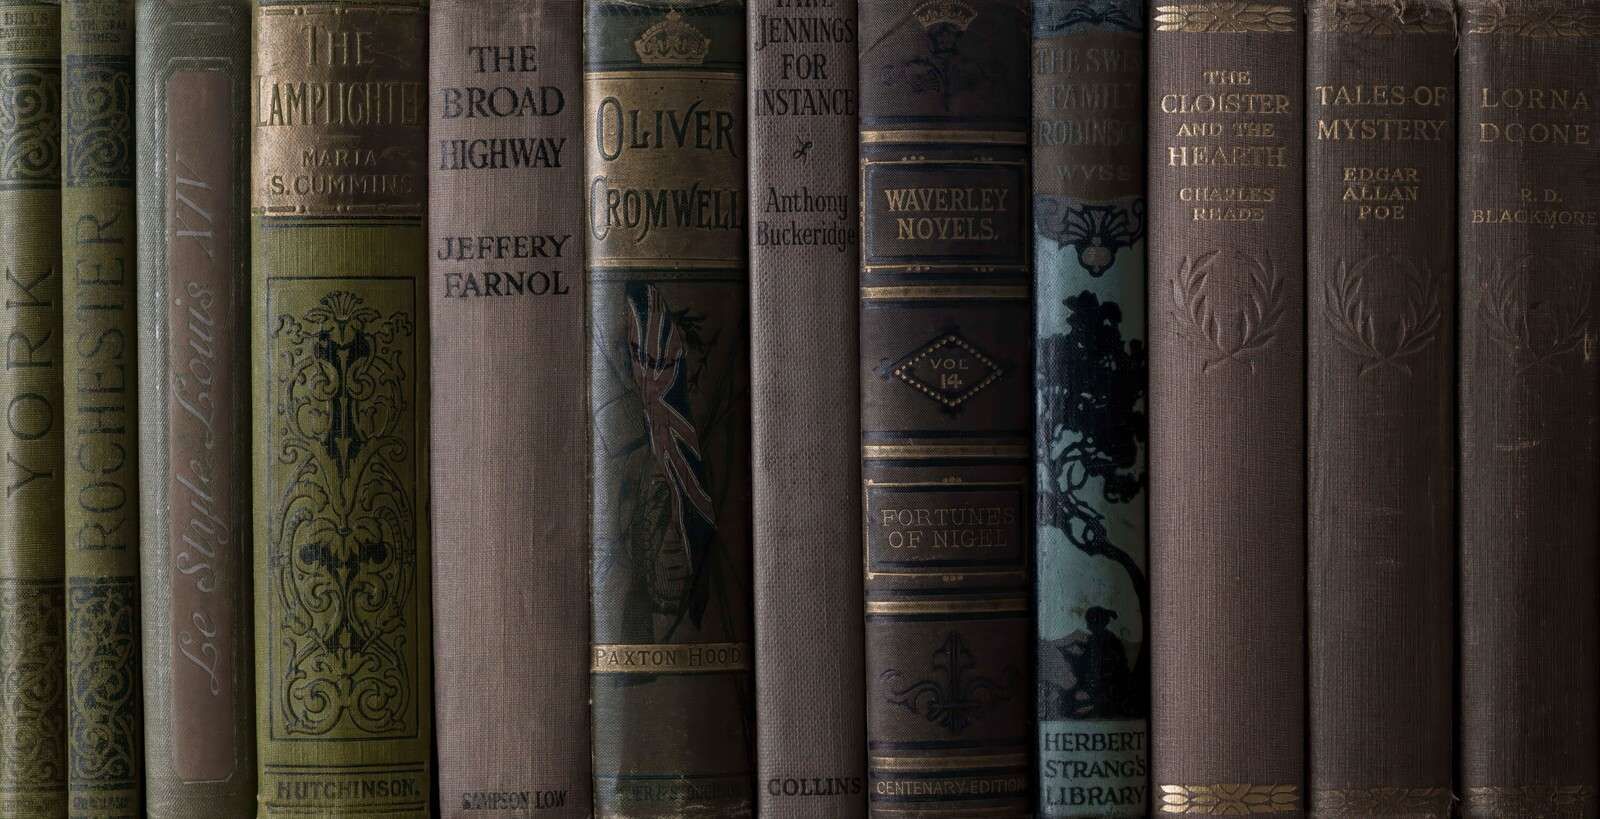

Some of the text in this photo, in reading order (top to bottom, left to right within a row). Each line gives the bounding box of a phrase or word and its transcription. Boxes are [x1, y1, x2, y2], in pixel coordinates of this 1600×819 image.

[754, 15, 855, 51] JENNINGS
[302, 24, 377, 66] THE
[468, 45, 538, 73] THE
[781, 53, 829, 80] FOR
[1202, 70, 1251, 86] THE
[442, 86, 565, 119] BROAD
[754, 89, 857, 116] INSTANCE
[1161, 93, 1292, 114] CLOISTER
[1481, 87, 1592, 109] LORNA
[596, 96, 742, 162] OLIVER
[1176, 122, 1276, 137] AND THE
[1315, 119, 1447, 141] MYSTERY
[1478, 122, 1591, 145] DOONE
[302, 149, 377, 167] MARIA
[439, 138, 567, 170] HIGHWAY
[1167, 145, 1289, 168] HEARTH
[1343, 167, 1419, 182] EDGAR
[765, 187, 849, 220] Anthony
[884, 188, 1009, 213] WAVERLEY
[1179, 187, 1276, 202] CHARLES
[1342, 186, 1418, 202] ALLAN
[590, 176, 745, 243] CROMWELL
[1358, 205, 1406, 221] POE
[1471, 209, 1598, 225] BLACKMORE
[757, 221, 858, 252] Buckeridge
[896, 217, 999, 241] NOVELS.
[437, 235, 572, 262] JEFFERY
[443, 270, 569, 298] FARNOL
[6, 267, 54, 498] YORK
[76, 211, 128, 551] ROCHESTER
[939, 373, 963, 389] 14
[173, 151, 229, 695] Le Style Louis XIV
[881, 508, 1016, 527] FORTUNES
[888, 529, 1008, 549] OF NIGEL
[593, 647, 743, 667] PAXTON HOOD
[1044, 731, 1145, 752] HERBERT
[1044, 754, 1147, 779] STRANG'S
[767, 777, 862, 797] COLLINS
[876, 776, 1025, 796] CENTENARY EDITION
[1046, 785, 1146, 806] LIBRARY
[462, 790, 568, 809] SAMPSON LOW
